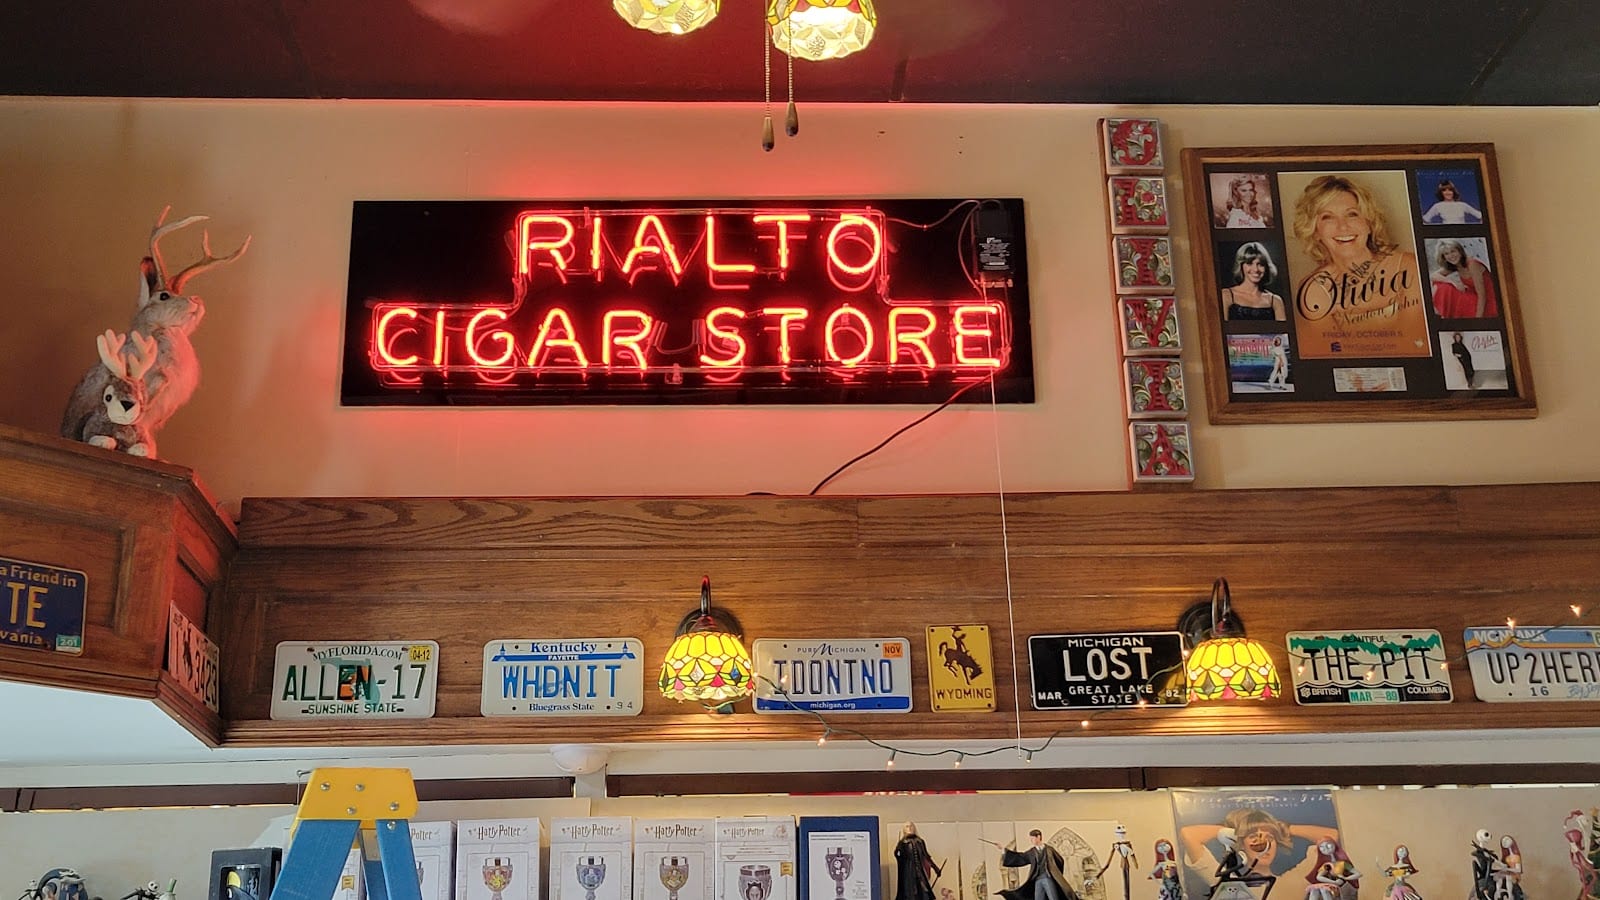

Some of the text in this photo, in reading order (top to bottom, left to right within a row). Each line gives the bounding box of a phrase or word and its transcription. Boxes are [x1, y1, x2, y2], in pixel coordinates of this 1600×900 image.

[521, 213, 882, 275] RIALTO
[1296, 268, 1412, 322] Olivia
[376, 306, 1003, 370] CIGAR STORE
[10, 564, 60, 585] Friend
[62, 574, 77, 588] in
[1067, 637, 1145, 648] MICHIGAN
[1341, 635, 1387, 643] BEAUTIFUL
[312, 644, 403, 662] MYFLORIDA.COM
[530, 641, 598, 654] Kentucky
[884, 645, 902, 656] NOV
[412, 649, 430, 661] 04-12
[547, 654, 580, 662] FAYETTE
[1062, 646, 1153, 682] LOST
[1303, 647, 1431, 681] THE PIT
[1486, 651, 1600, 684] UP2HER
[281, 663, 428, 701] ALLEN-17
[936, 687, 992, 700] WYOMING
[1068, 684, 1154, 695] GREAT LAKE
[1165, 689, 1180, 698] 82
[1311, 687, 1342, 696] BRITISH
[1406, 685, 1449, 695] COLUMBIA
[1530, 686, 1550, 697] 16
[1038, 691, 1063, 701] MAR
[1091, 694, 1133, 705] STATE
[1349, 690, 1398, 702] MAR 89
[307, 702, 398, 715] SUNSHINE STATE
[528, 702, 595, 713] Bluegrass State
[810, 702, 857, 710] michigan.org
[411, 828, 433, 841] Potter
[478, 824, 521, 841] Harry Potter
[571, 823, 613, 839] Harry Potter
[655, 823, 697, 839] Harry Potter
[731, 827, 765, 839] Harry Potter
